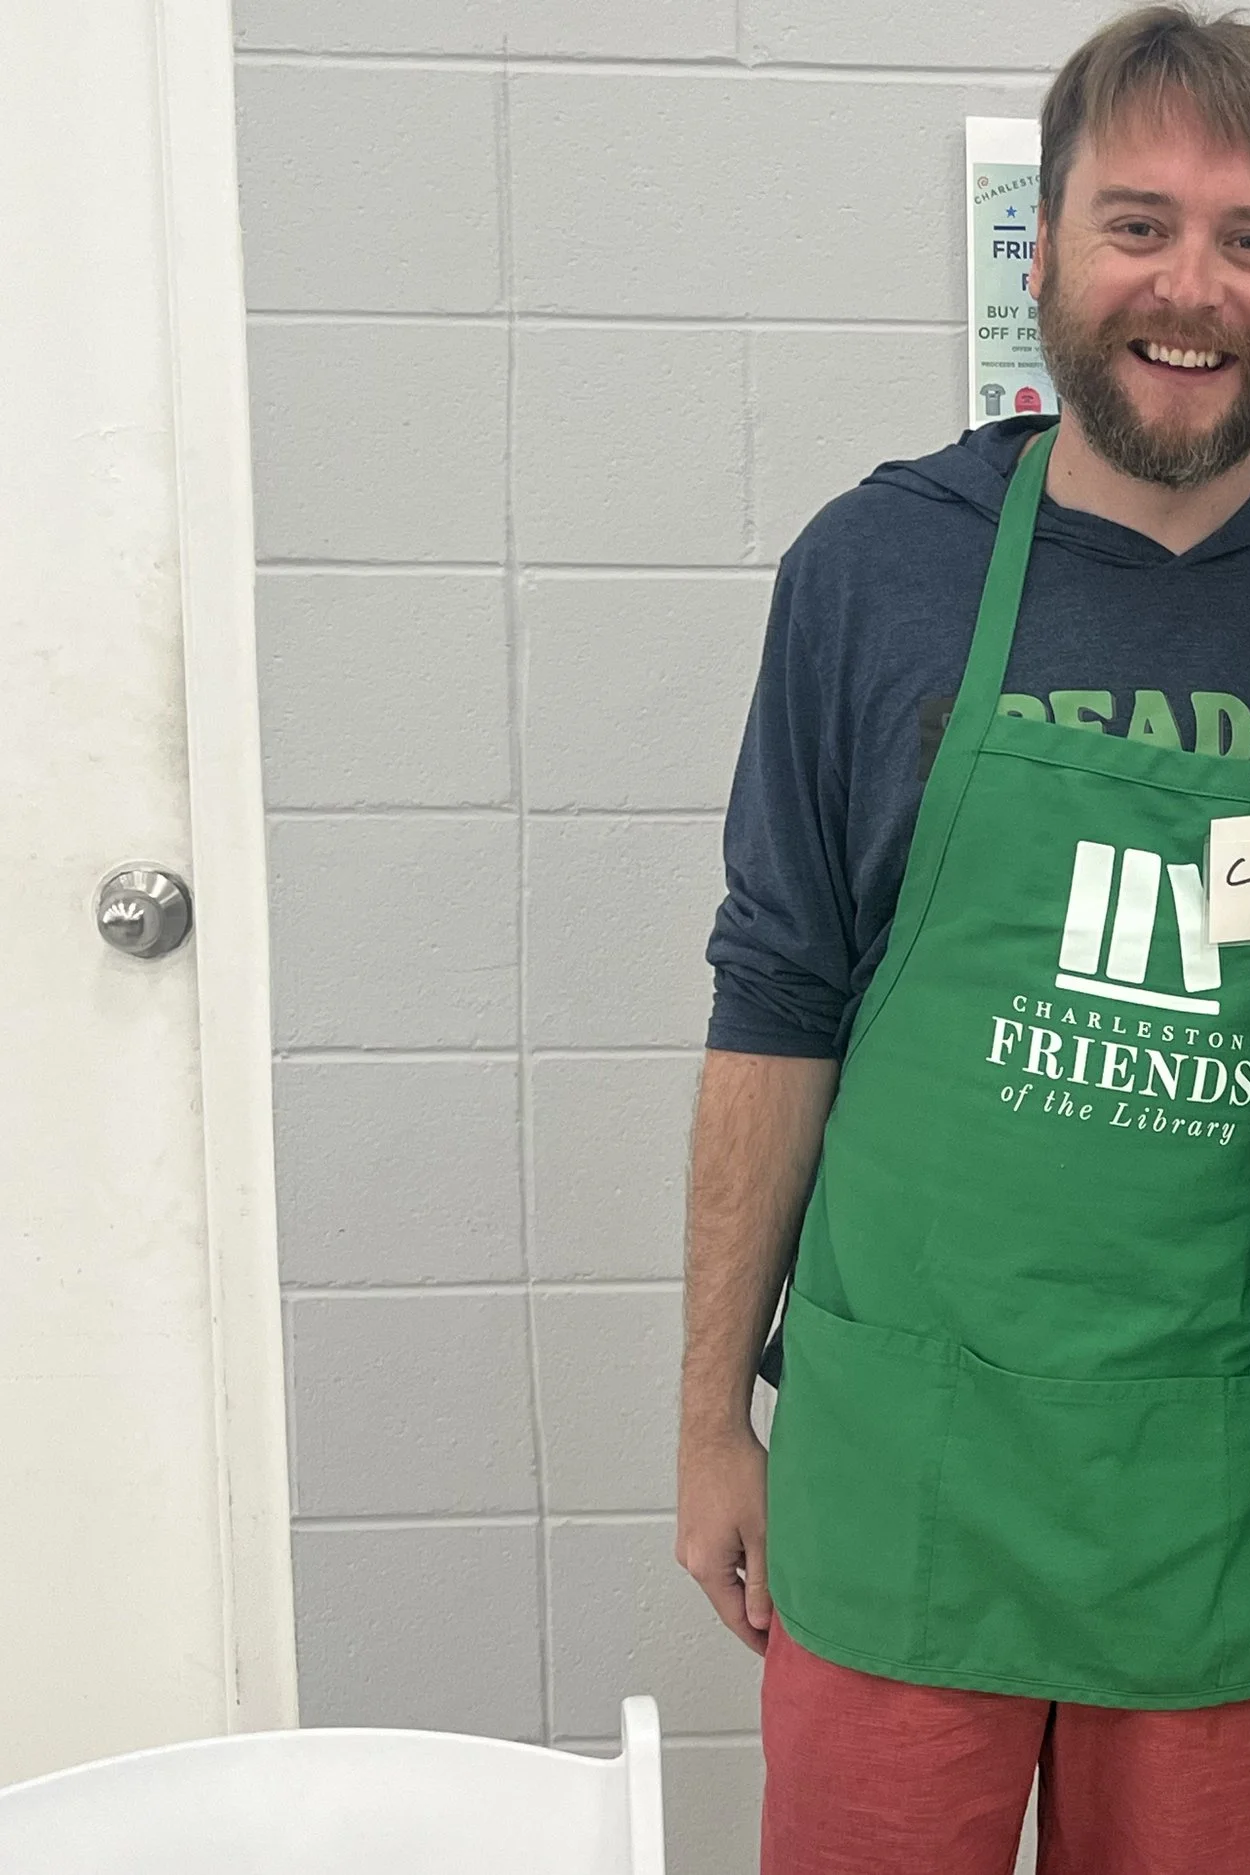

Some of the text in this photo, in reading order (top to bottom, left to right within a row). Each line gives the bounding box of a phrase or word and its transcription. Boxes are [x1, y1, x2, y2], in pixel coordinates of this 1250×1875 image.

[987, 305, 1019, 318] BUY
[978, 326, 1009, 340] OFF
[1013, 995, 1246, 1050] CHARLESTON
[1000, 1083, 1237, 1146] of the Library
